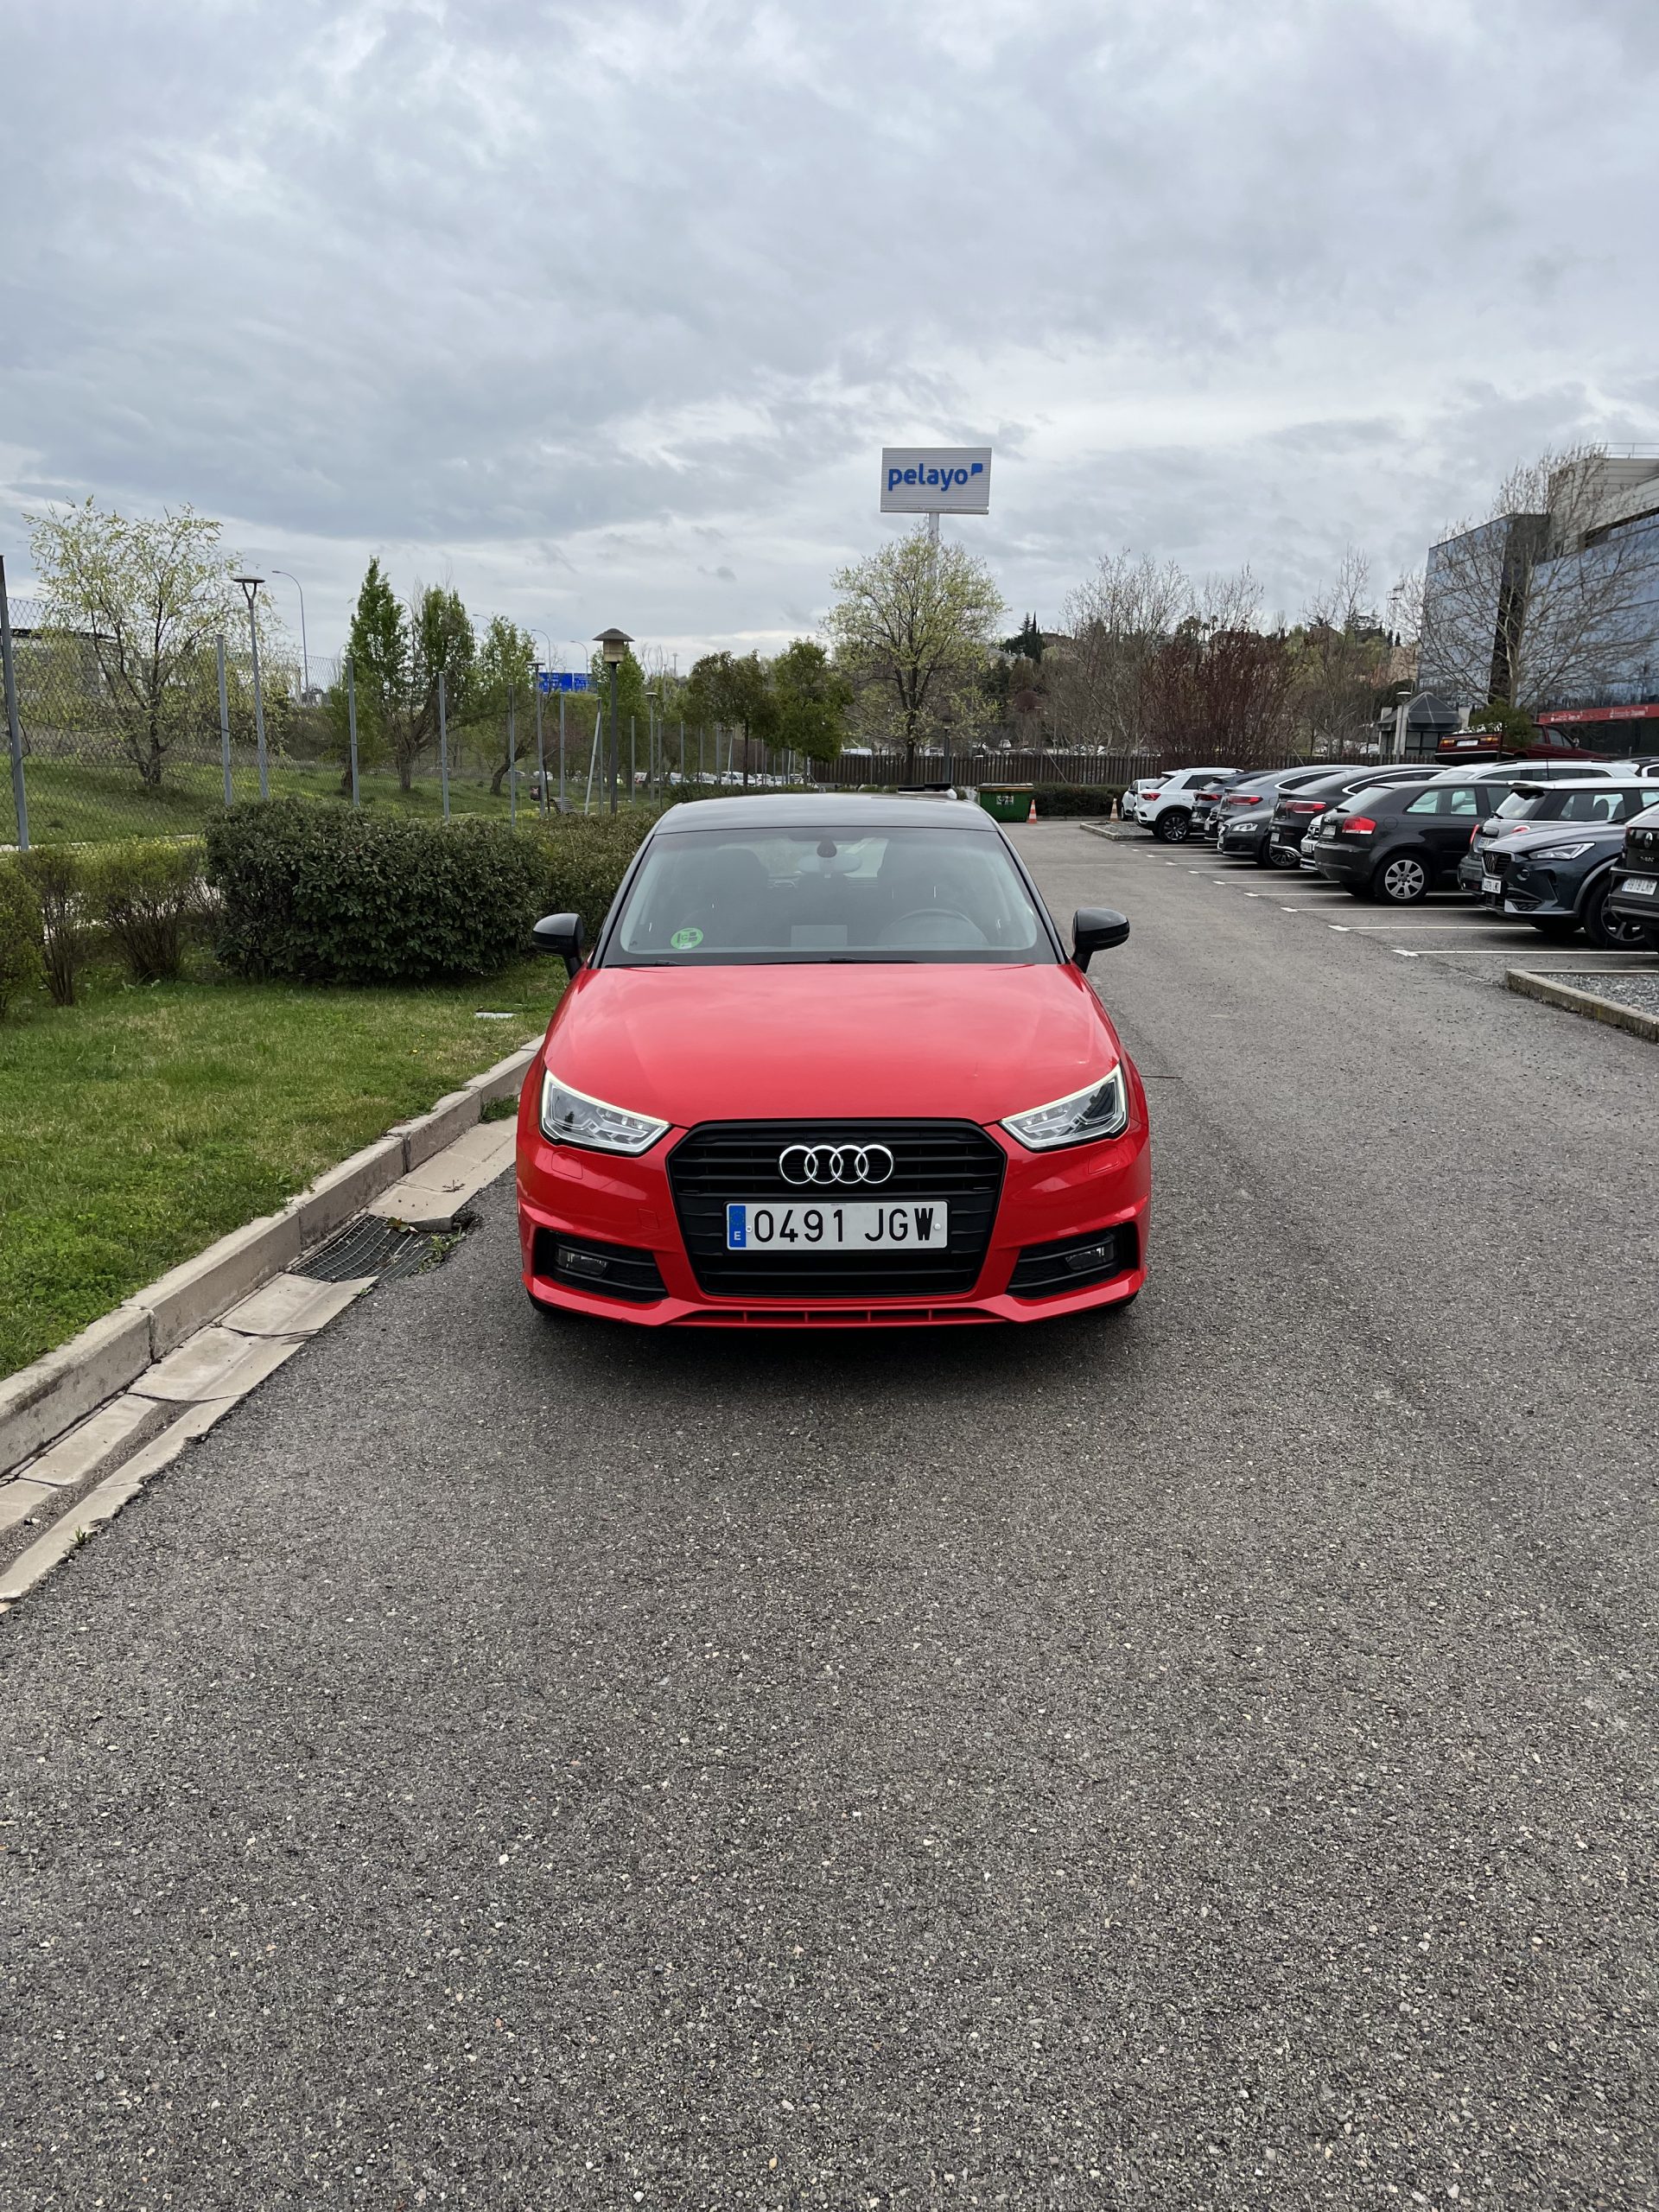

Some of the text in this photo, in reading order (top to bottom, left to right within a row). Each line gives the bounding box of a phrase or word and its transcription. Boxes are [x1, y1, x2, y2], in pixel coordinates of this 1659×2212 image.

[887, 462, 969, 492] pelayo
[734, 1207, 934, 1243] E 0491 JGW
